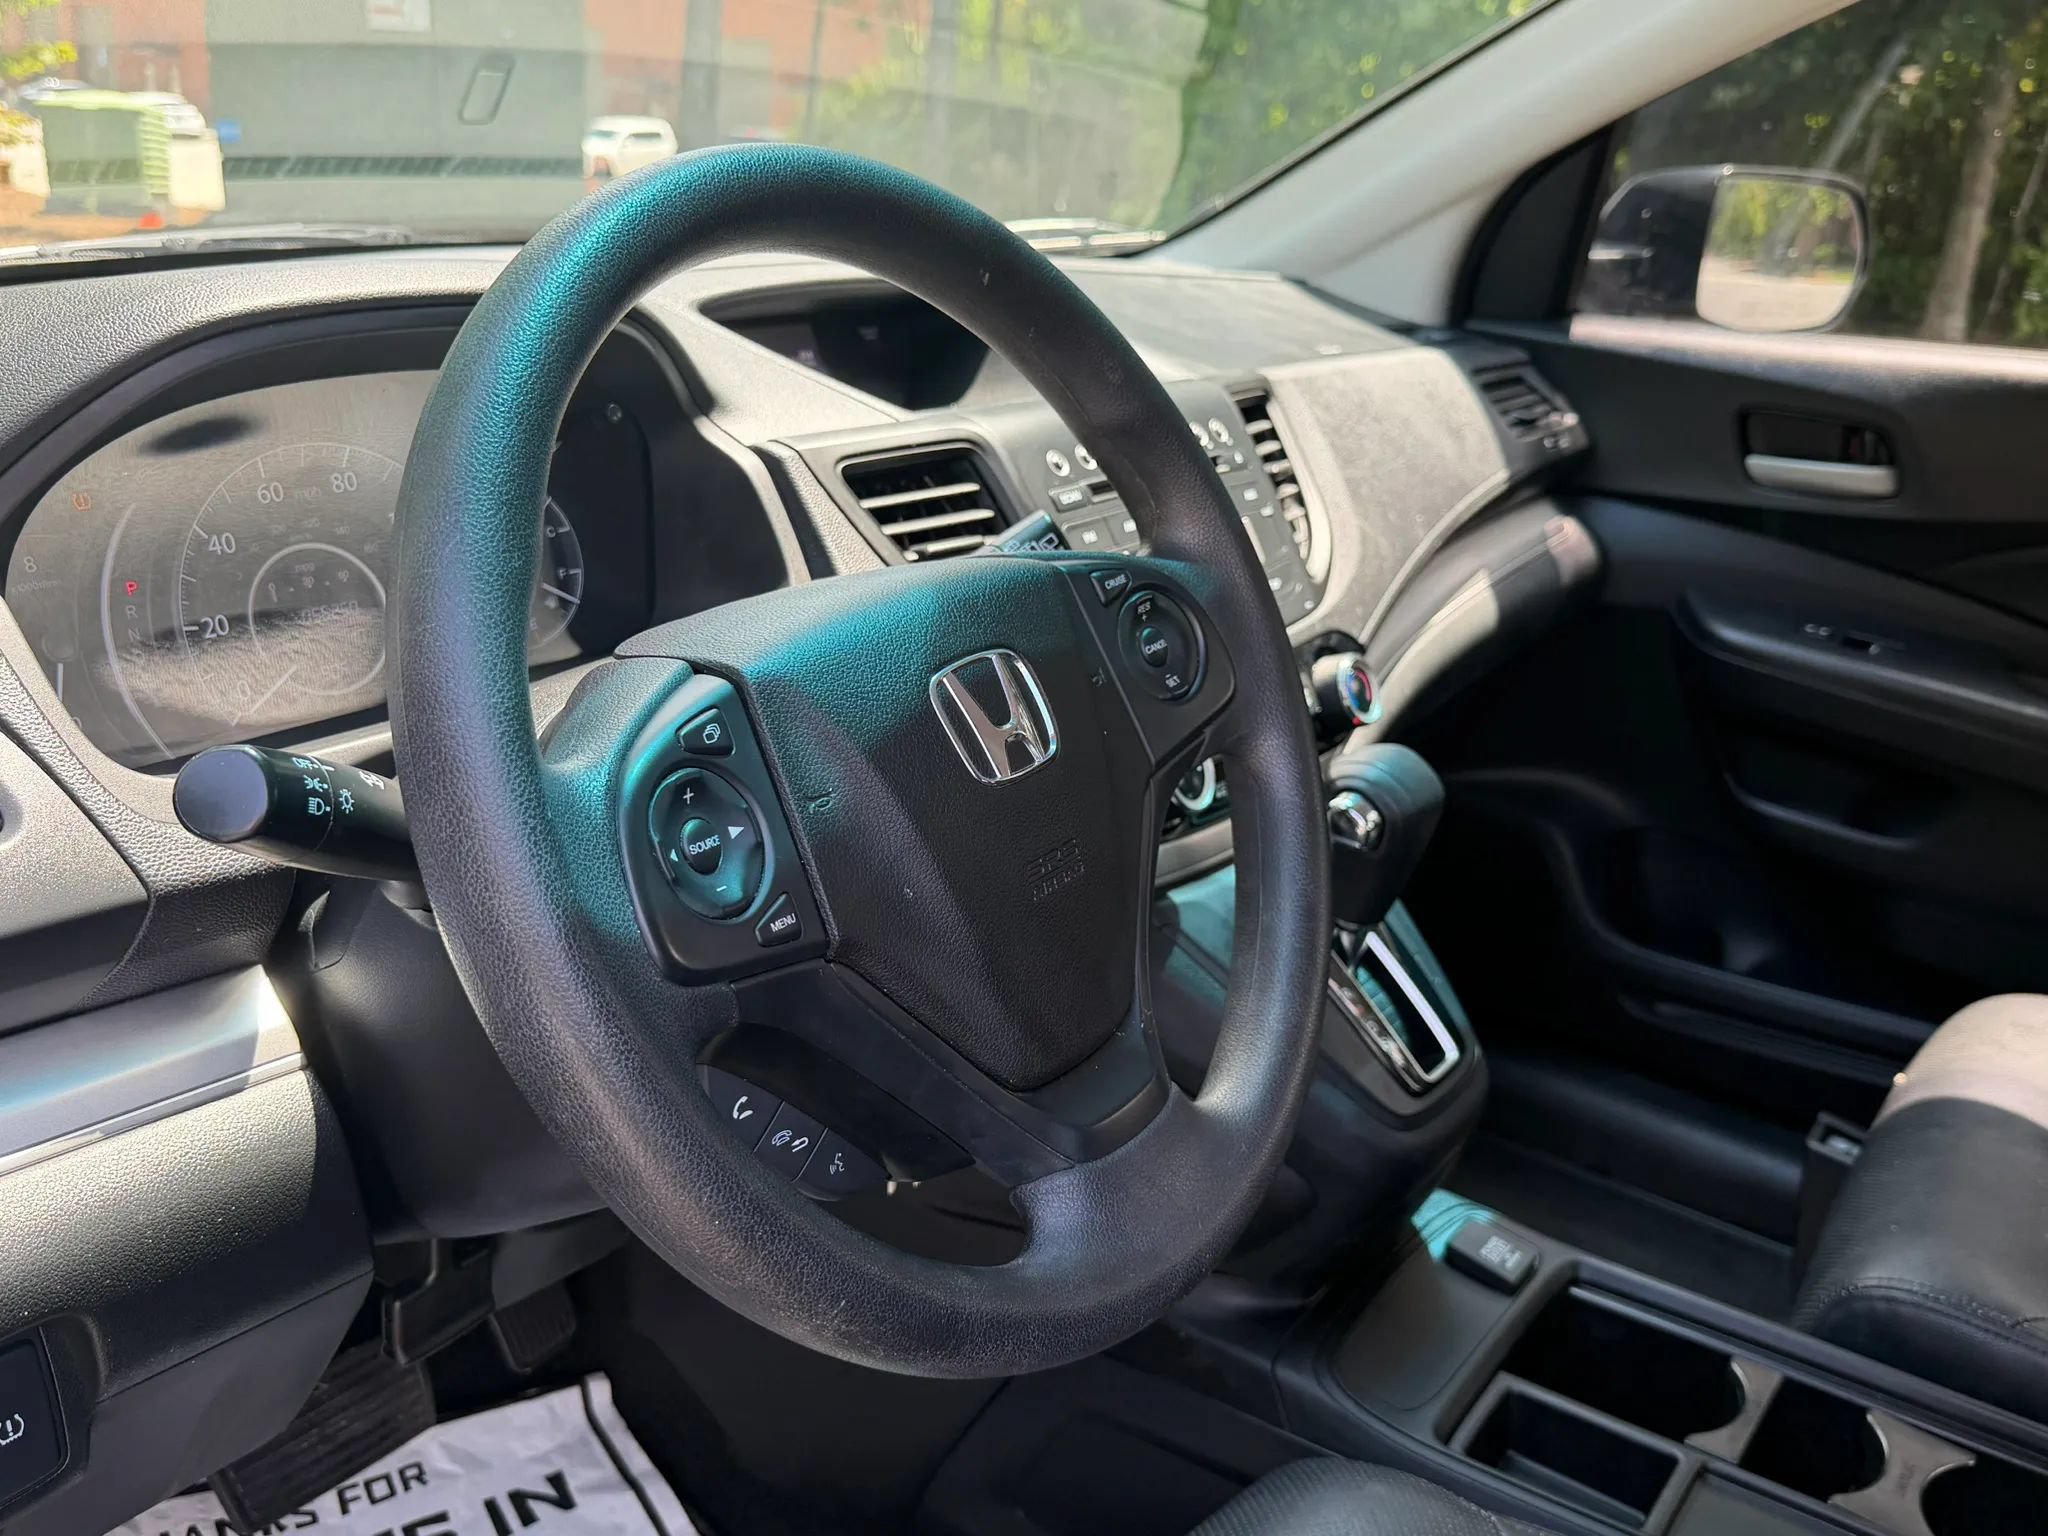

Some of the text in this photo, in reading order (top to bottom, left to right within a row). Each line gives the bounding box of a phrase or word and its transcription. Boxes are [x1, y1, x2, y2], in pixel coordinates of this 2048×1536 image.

[257, 482, 284, 504] 60
[331, 472, 357, 493] 80
[207, 532, 236, 555] 40
[24, 556, 37, 573] 8
[126, 581, 138, 596] P
[1104, 574, 1128, 590] CRUISE
[126, 605, 139, 619] R
[201, 614, 231, 639] 20
[689, 834, 721, 855] SOURCE
[769, 912, 797, 933] MENU
[336, 1461, 428, 1516] FOR
[483, 1468, 578, 1536] IN
